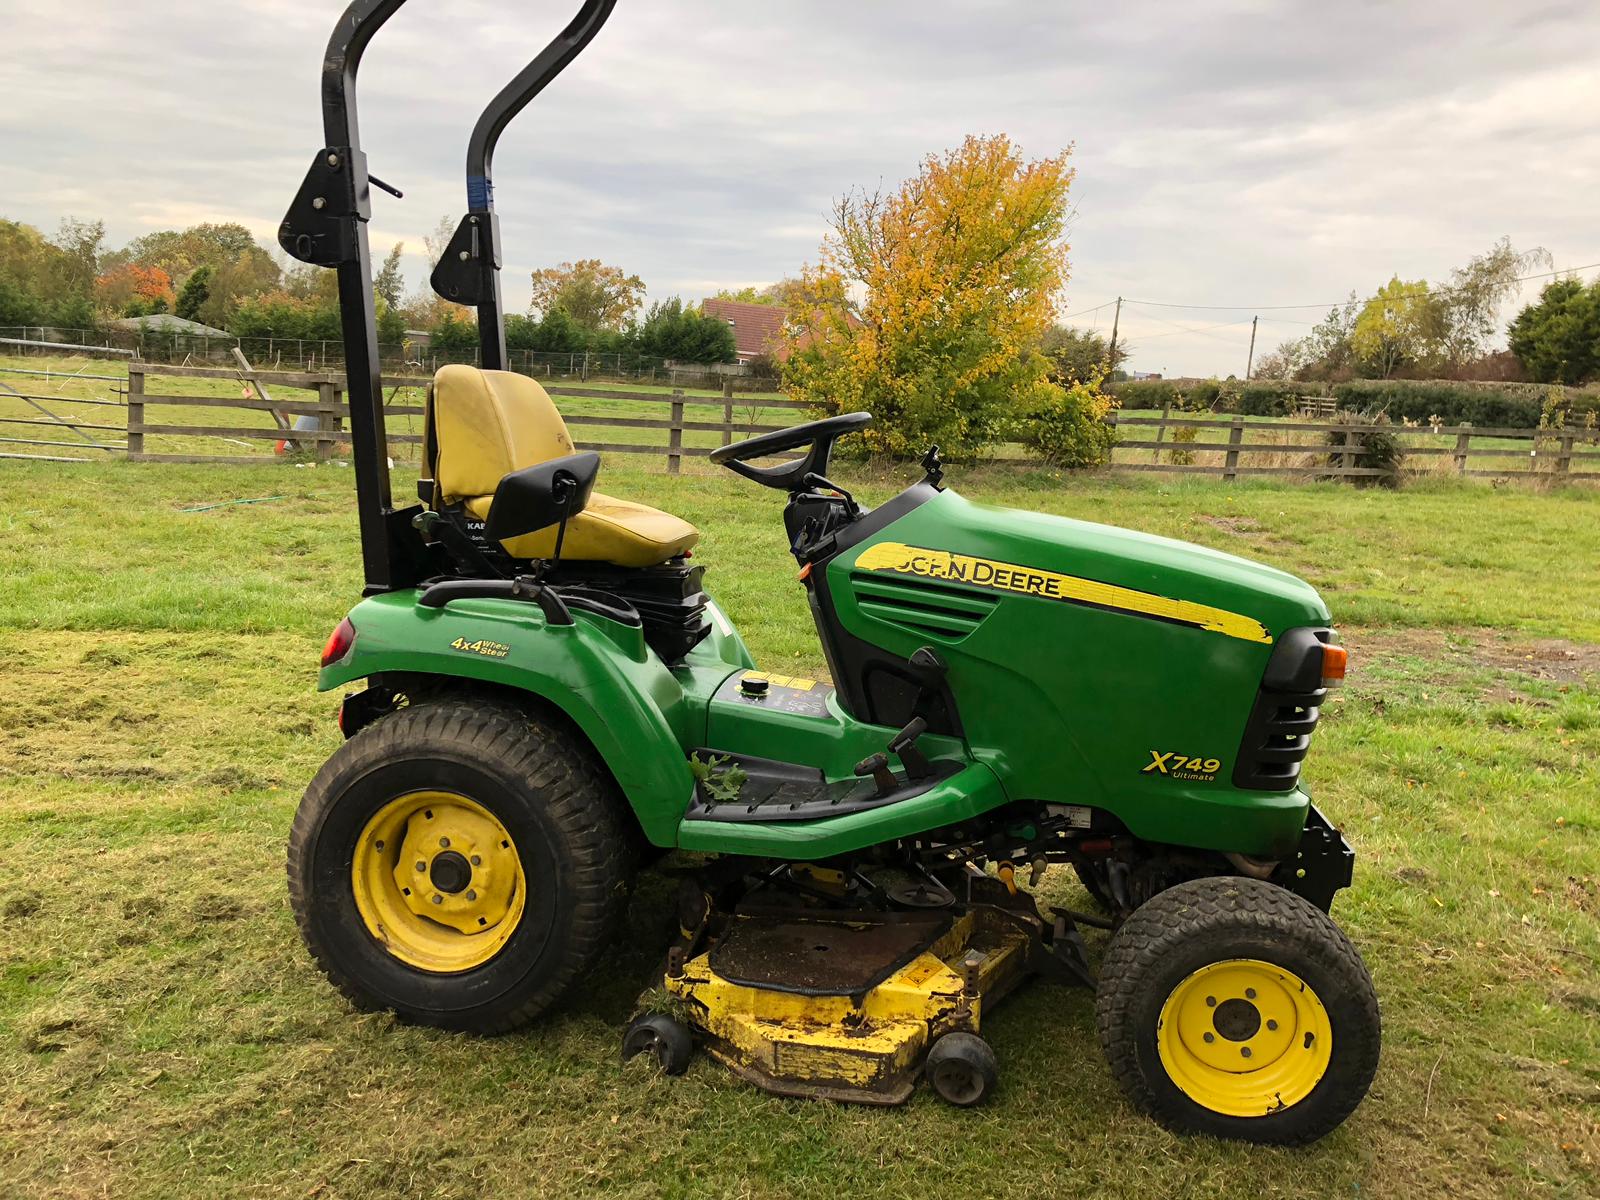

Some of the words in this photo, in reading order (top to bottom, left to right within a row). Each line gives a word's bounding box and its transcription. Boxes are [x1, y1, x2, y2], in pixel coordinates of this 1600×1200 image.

[972, 562, 1062, 596] DEERE
[450, 637, 483, 652] 4x4
[482, 640, 510, 651] Wheel
[480, 647, 507, 657] Steer
[1142, 750, 1221, 773] X749
[1173, 771, 1215, 781] Ultimate
